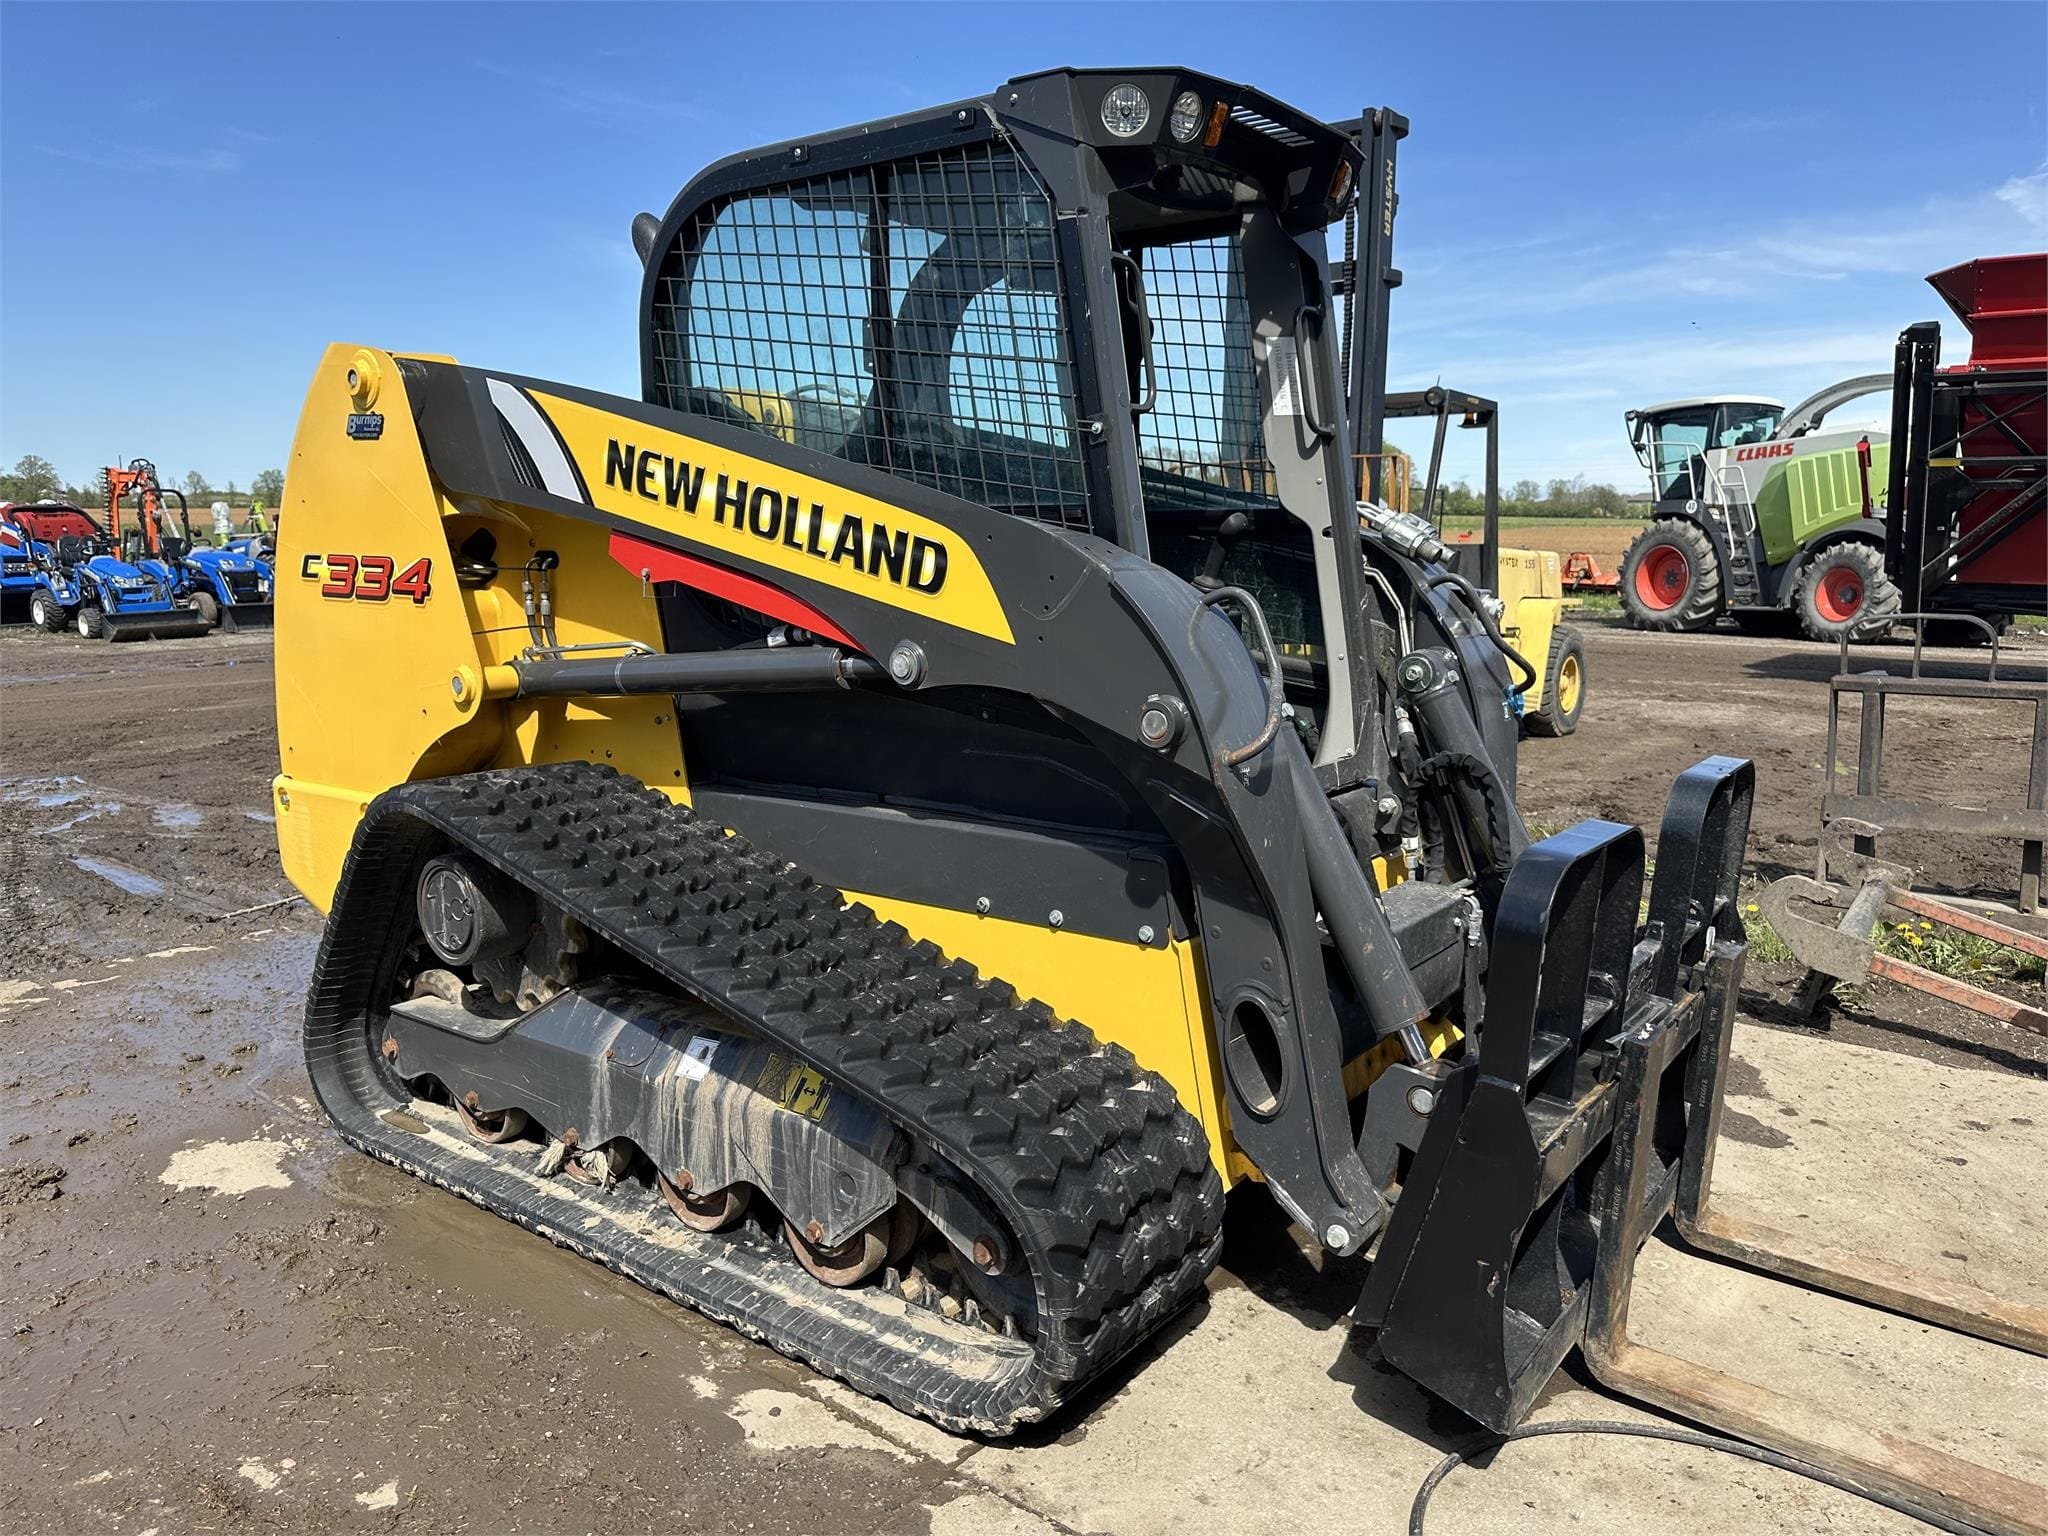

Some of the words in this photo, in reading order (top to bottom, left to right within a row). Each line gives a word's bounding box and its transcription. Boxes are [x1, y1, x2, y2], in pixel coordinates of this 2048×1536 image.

[1383, 158, 1394, 237] HYSTER
[347, 413, 383, 434] Burnips
[1736, 442, 1795, 462] CLAAS
[604, 437, 706, 515] NEW
[713, 471, 949, 596] HOLLAND
[301, 553, 432, 605] C334
[1524, 559, 1536, 569] 155
